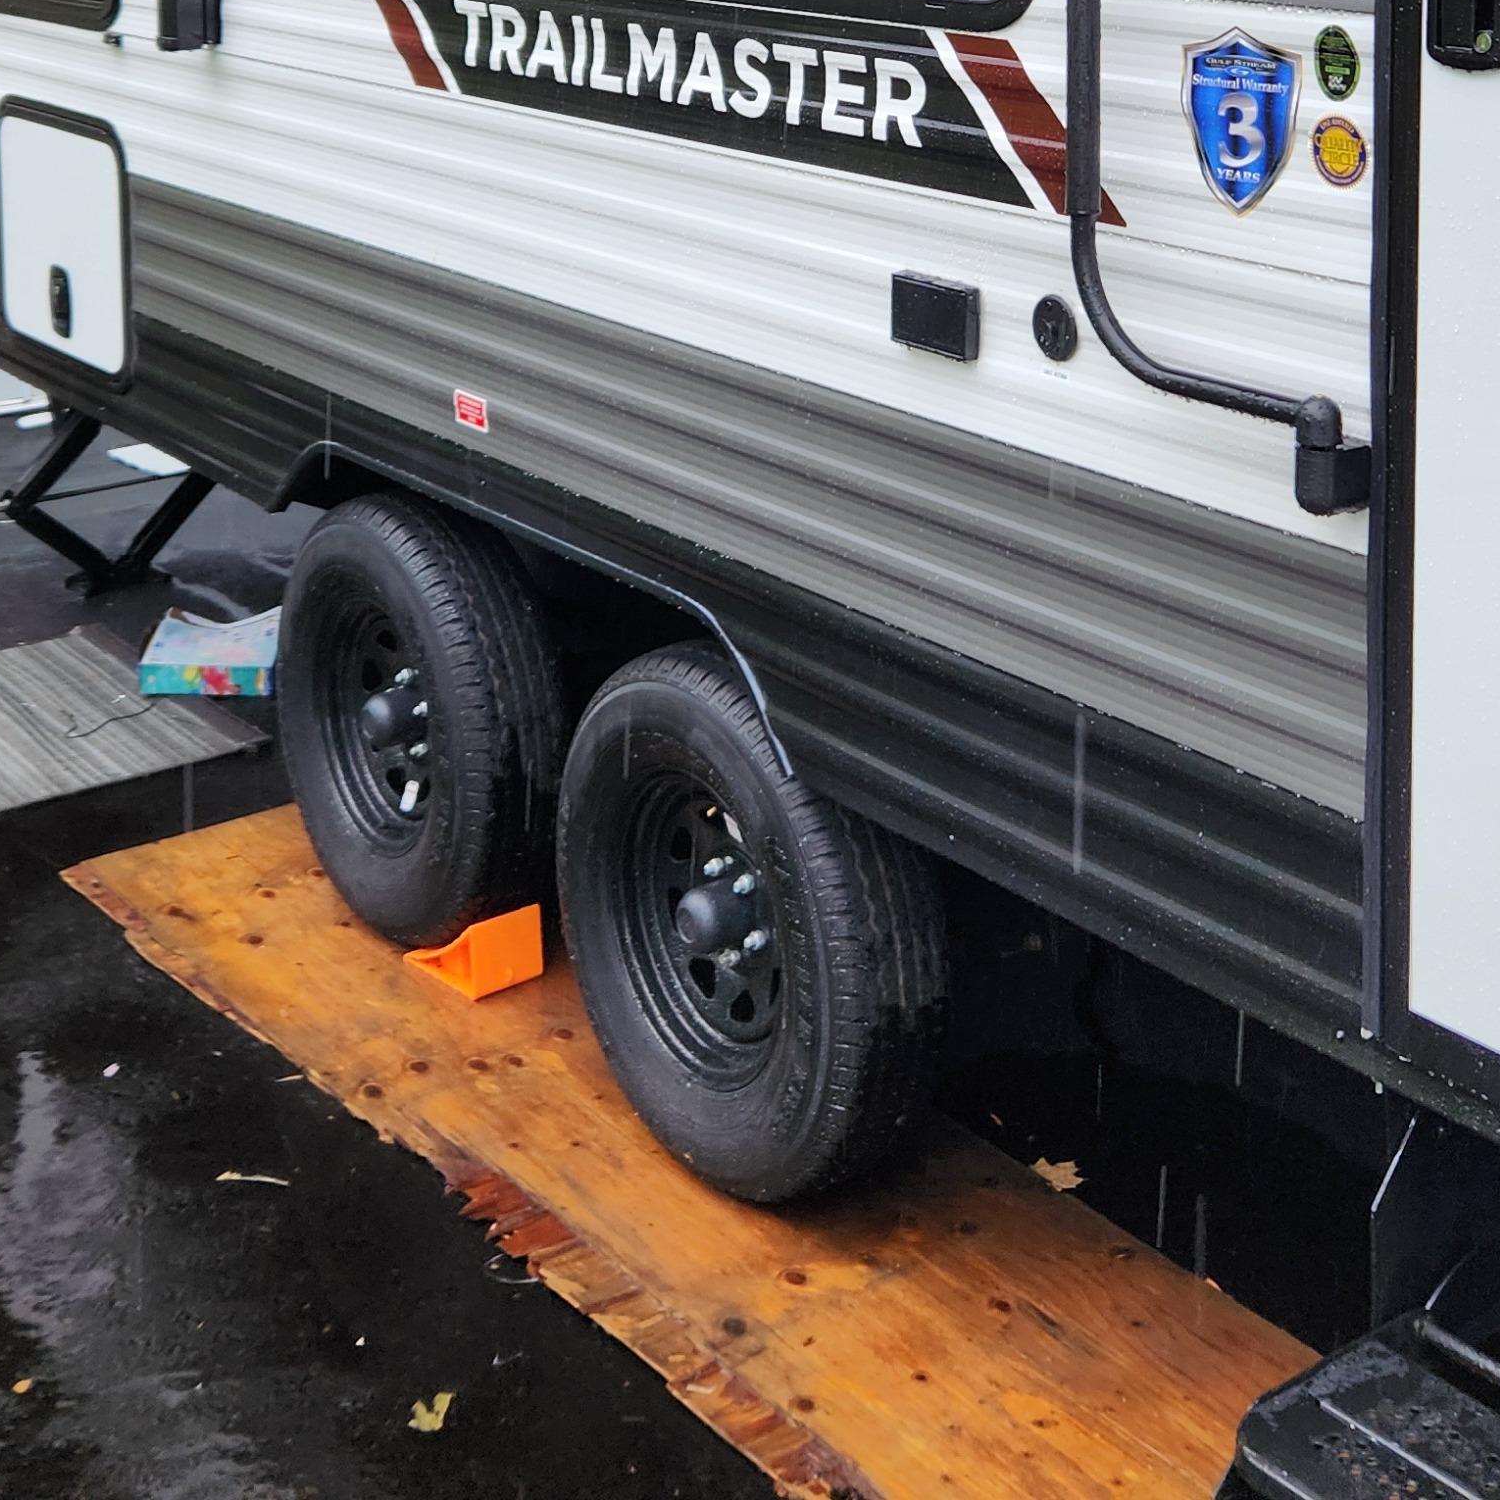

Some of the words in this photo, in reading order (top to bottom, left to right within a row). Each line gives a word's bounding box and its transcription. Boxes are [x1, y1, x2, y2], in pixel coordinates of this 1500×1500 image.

[1192, 73, 1240, 90] Structural
[1242, 77, 1290, 97] Warranty
[1217, 91, 1266, 168] 3
[1217, 167, 1261, 184] YEARS
